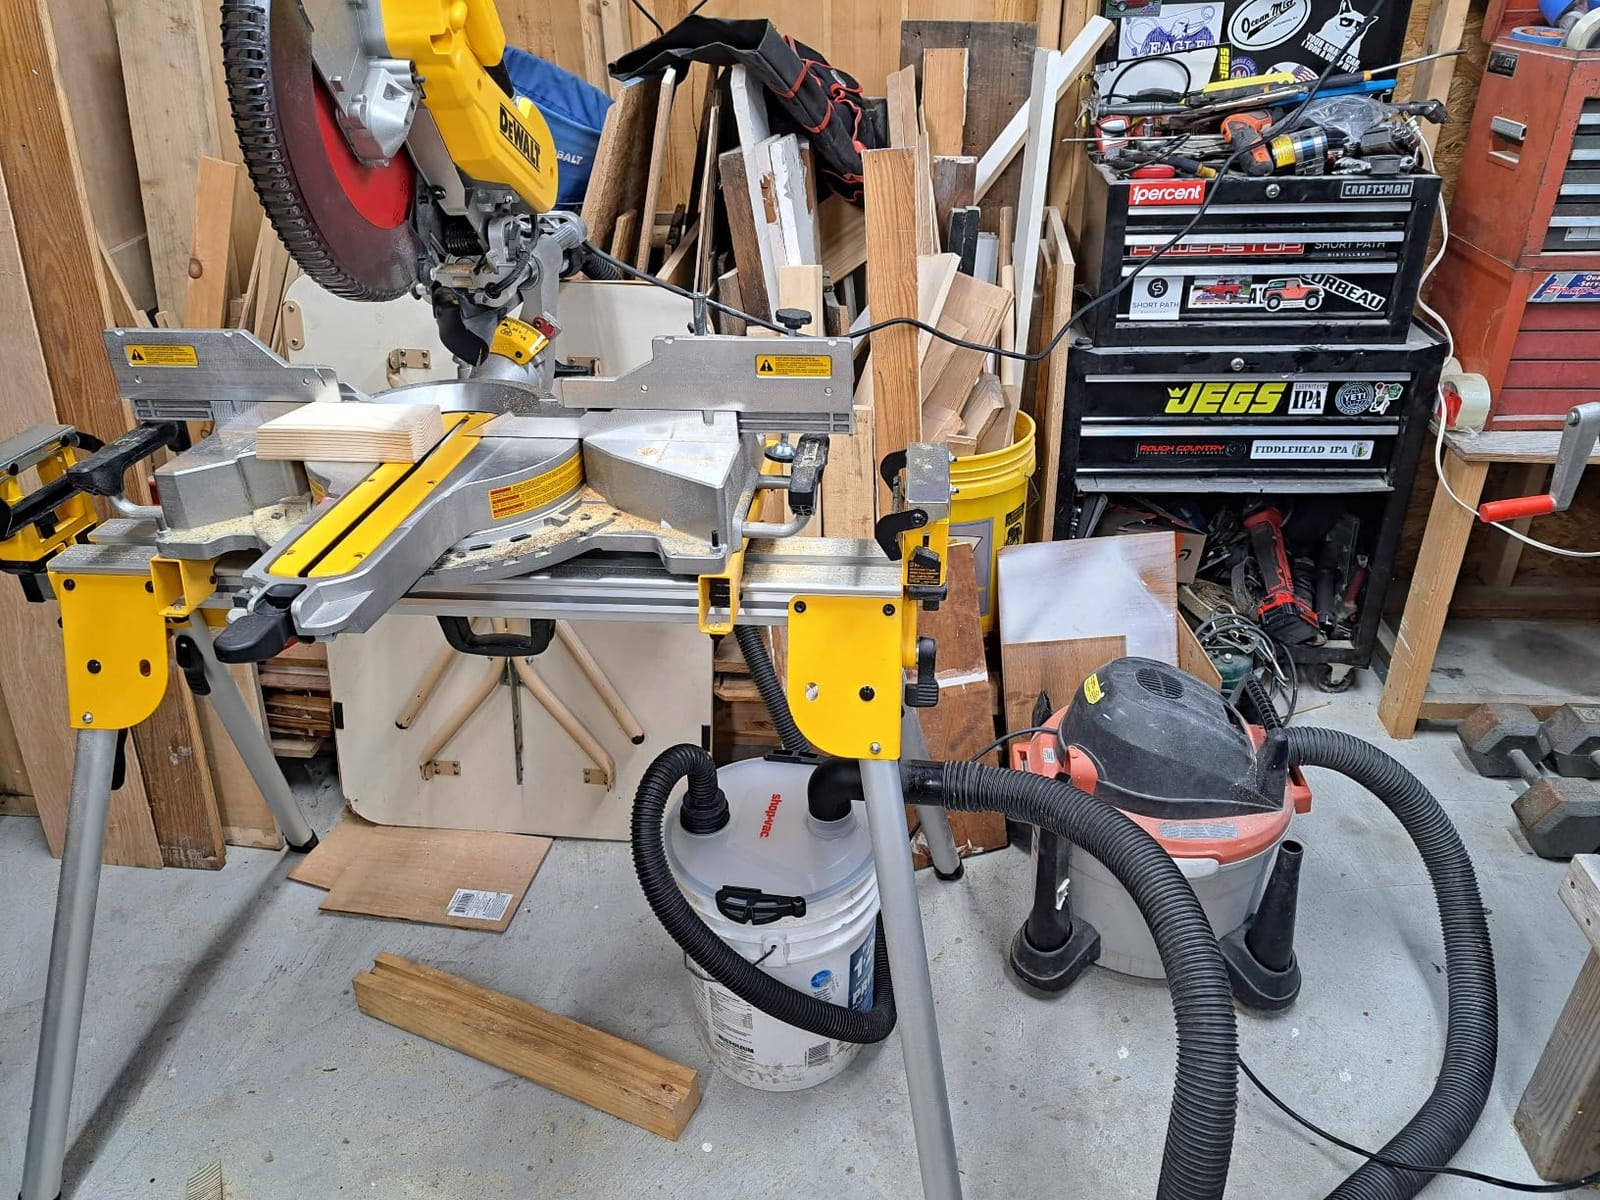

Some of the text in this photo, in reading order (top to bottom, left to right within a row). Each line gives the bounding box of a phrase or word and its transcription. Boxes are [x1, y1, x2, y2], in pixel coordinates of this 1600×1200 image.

[1241, 13, 1269, 33] Ocean
[1270, 0, 1293, 16] Mis
[1304, 41, 1321, 55] TOOK
[1319, 50, 1326, 58] A
[1324, 53, 1344, 67] DUP
[1306, 32, 1325, 48] YOUR
[1323, 42, 1347, 61] SMAT
[1219, 47, 1230, 80] JEGS
[499, 104, 541, 170] DEWALT
[556, 150, 583, 165] BALT
[1133, 185, 1202, 204] 1percent
[1345, 184, 1410, 195] CRAFTSMAN
[1314, 242, 1385, 250] SHORT PATH
[1164, 383, 1288, 413] JEGS
[1292, 390, 1321, 409] IPA
[1344, 391, 1366, 401] YETI
[1255, 445, 1325, 453] FIDDLEHEAD
